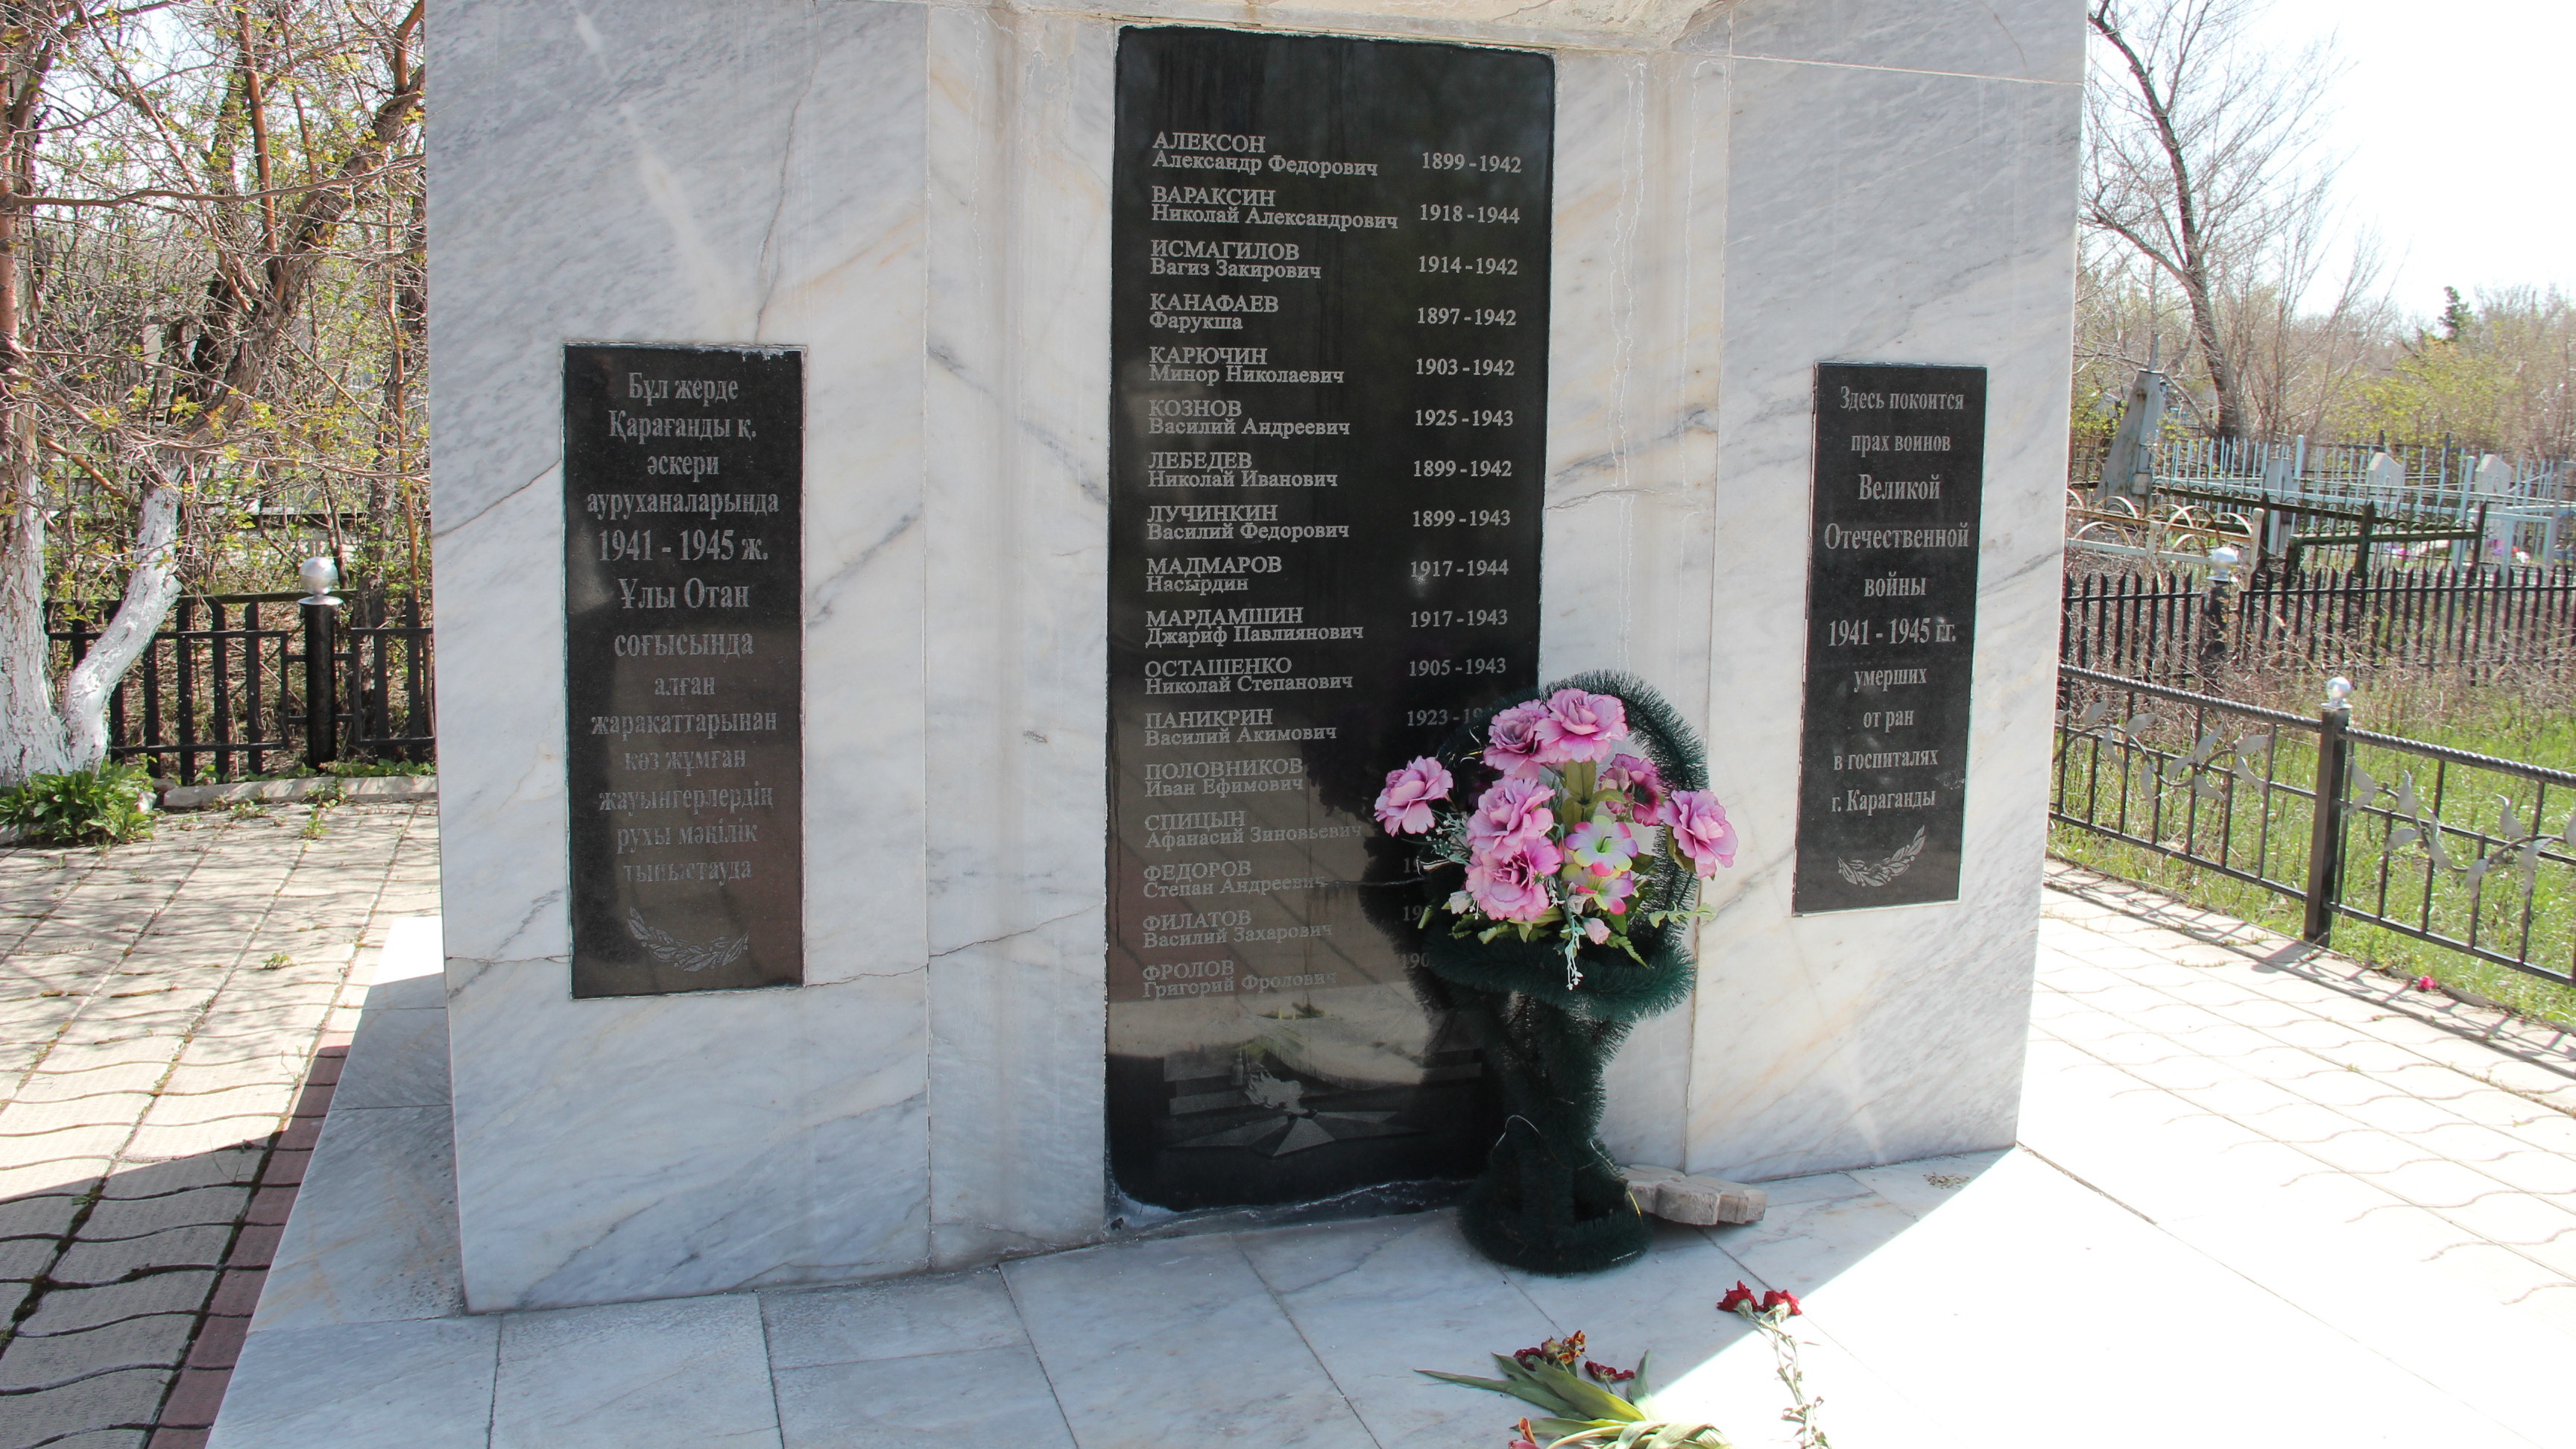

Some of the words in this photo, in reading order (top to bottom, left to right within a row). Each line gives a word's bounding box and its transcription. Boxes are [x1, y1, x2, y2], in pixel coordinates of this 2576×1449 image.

[1152, 131, 1266, 153] АЛЕКСОН
[1152, 150, 1262, 175] Александр
[1268, 155, 1377, 178] Федорович
[1152, 186, 1276, 206] ВАРАКСИН
[1152, 203, 1240, 223] Николай
[1245, 207, 1398, 231] Александрович
[1150, 239, 1299, 260] ИСМАГИЛОВ
[1150, 258, 1210, 276] Вагиз
[1216, 259, 1322, 282] Закирович
[1150, 293, 1279, 312] КАНАФАЕВ
[1149, 312, 1243, 332] Фарукша
[1149, 347, 1267, 364] КАРЮЧИН
[1149, 364, 1219, 386] Минор
[1225, 365, 1344, 383] Николаевич
[628, 373, 668, 405] Бұл
[675, 378, 738, 406] жерде
[1840, 386, 1884, 411] Здесь
[1890, 394, 1964, 410] покоится
[1149, 400, 1242, 417] КОЗНОВ
[609, 411, 730, 443] Қарағанды
[1149, 417, 1236, 435] Василий
[1242, 417, 1350, 438] Андреевич
[1851, 435, 1890, 458] прах
[1895, 435, 1951, 452] воинов
[648, 456, 719, 482] әскери
[1148, 452, 1252, 473] ЛЕБЕДЕВ
[1148, 470, 1234, 487] Николай
[1241, 470, 1338, 487] Иванович
[1858, 473, 1941, 500] Великой
[587, 493, 779, 520] ауруханаларында
[1147, 505, 1278, 522] ЛУЧИНКИН
[1147, 523, 1234, 540] Василий
[1240, 523, 1349, 542] Федорович
[1824, 522, 1969, 549] Отечественной
[599, 529, 653, 561] 1941
[680, 529, 734, 561] 1945
[742, 539, 768, 560] ж.
[1146, 556, 1282, 578] МАДМАРОВ
[618, 578, 675, 609] Ұлы
[684, 578, 749, 609] Отан
[1146, 575, 1248, 596] Насырдин
[1864, 571, 1926, 596] войны
[1146, 607, 1304, 629] МАРДАМШИН
[1145, 626, 1228, 648] Джариф
[1234, 625, 1363, 643] Павлиянович
[1828, 619, 1869, 646] 1941
[1889, 617, 1931, 645] 1945
[1936, 624, 1957, 643] гг.
[614, 633, 754, 657] соғысында
[1145, 657, 1292, 678] ОСТАШЕНКО
[654, 677, 716, 695] алған
[1145, 676, 1231, 695] Николай
[1237, 675, 1353, 692] Степанович
[1854, 668, 1927, 692] умерших
[1145, 709, 1273, 729] ПАНИКРИН
[1863, 712, 1881, 728] от
[1884, 710, 1914, 733] ран
[1145, 727, 1230, 746] Василий
[1237, 727, 1336, 743] Акимович
[666, 749, 746, 776] жұмған
[1145, 757, 1304, 781] ПОЛОВНИКОВ
[1834, 754, 1843, 771] в
[1848, 749, 1938, 771] госпиталях
[1145, 780, 1196, 798] Иван
[1202, 777, 1304, 798] Ефимович
[1831, 797, 1841, 812] г.
[1846, 789, 1936, 815] Караганды
[1144, 810, 1246, 832] СПИЦЫН
[617, 827, 671, 854] рухы
[1145, 827, 1244, 852] Афанасий
[1250, 824, 1362, 843] Зиновьевич
[1143, 860, 1251, 884] ФЕДОРОВ
[1143, 880, 1213, 898] Степан
[1143, 910, 1251, 932] ФИЛАТОВ
[1143, 929, 1228, 948] Василий
[1142, 960, 1234, 983] ФРОЛОВ
[1143, 976, 1234, 1000] Григорий
